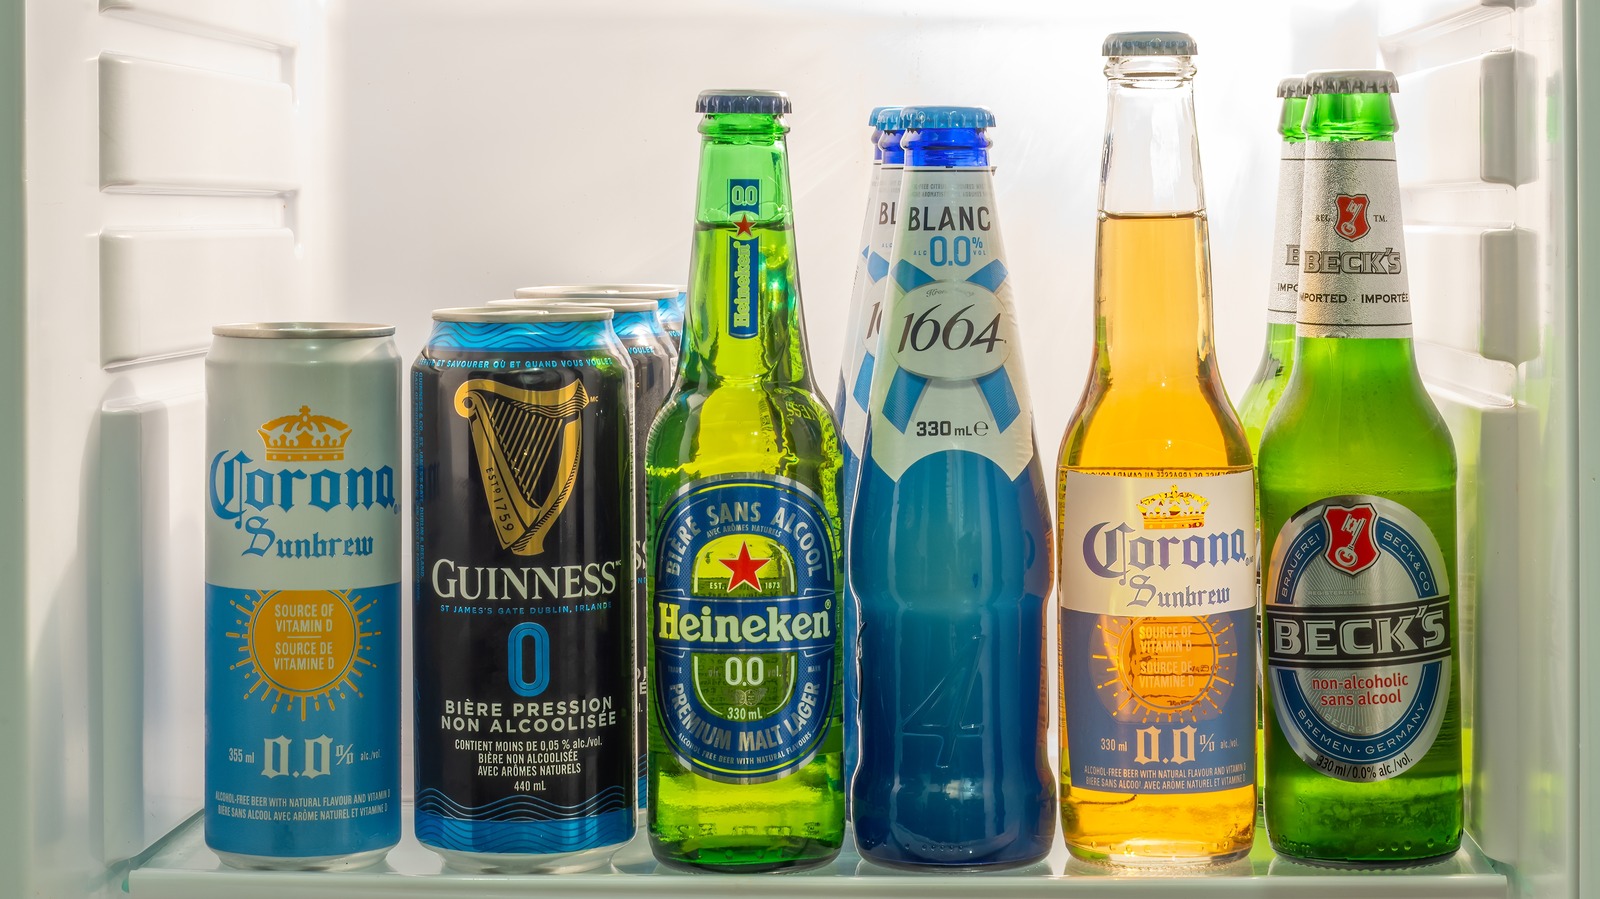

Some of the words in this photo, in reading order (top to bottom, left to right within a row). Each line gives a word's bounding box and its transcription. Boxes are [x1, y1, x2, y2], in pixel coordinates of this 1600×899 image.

[731, 185, 758, 206] 0.0
[908, 206, 991, 231] BLANC
[1373, 214, 1388, 223] TM.
[929, 235, 983, 267] 0.0%
[1304, 247, 1402, 274] BECK'S
[734, 243, 750, 327] Heineken
[1277, 282, 1299, 292] IMPO
[898, 303, 1005, 353] 1664
[447, 360, 489, 368] SAVOURER
[493, 359, 506, 369] OÙ
[524, 360, 557, 368] QUAND
[561, 359, 583, 367] VOUS
[586, 358, 612, 366] VOULEZ
[916, 421, 951, 437] 330
[955, 426, 972, 436] mL
[209, 450, 396, 530] Corona
[494, 497, 514, 531] 1759
[241, 516, 374, 559] Sunbrew
[665, 515, 702, 577] BIÈRE
[706, 501, 762, 526] SANS
[770, 507, 823, 578] ALCOOL
[706, 527, 721, 538] AVEC
[723, 522, 749, 533] ARÔMES
[751, 524, 782, 538] NATURELS
[1082, 521, 1246, 586] Corona
[1281, 533, 1320, 598] BRAUEREI
[432, 558, 616, 600] GUINNESS
[709, 582, 725, 590] EST.
[765, 581, 781, 590] 1873
[1126, 574, 1230, 608] Sunbrew
[274, 603, 316, 618] SOURCE
[321, 603, 335, 617] OF
[440, 604, 450, 612] ST
[453, 605, 493, 615] JAMES'S
[498, 607, 524, 615] GATE
[575, 602, 612, 613] IRLANDE
[275, 619, 322, 633] VITAMIN
[325, 619, 333, 632] D
[658, 602, 831, 643] Heineken
[1139, 625, 1178, 639] SOURCE
[1181, 625, 1193, 639] OF
[1273, 605, 1446, 656] BECK'S
[275, 642, 316, 655] SOURCE
[319, 641, 333, 655] DE
[1140, 640, 1183, 653] VITAMIN
[1186, 640, 1192, 652] D
[273, 657, 324, 671] VITAMINE
[327, 657, 335, 670] D
[508, 621, 550, 697] 0
[1140, 661, 1178, 674] SOURCE
[1181, 661, 1192, 674] DE
[725, 656, 764, 687] 0.0
[1139, 675, 1185, 688] VITAMINE
[1189, 675, 1195, 686] D
[1312, 673, 1408, 690] non-alcoholic
[445, 698, 503, 718] BIÈRE
[513, 696, 613, 718] PRESSION
[1321, 694, 1354, 706] sans
[1358, 689, 1402, 705] alcool
[441, 716, 480, 733] NON
[490, 707, 617, 733] ALCOOLISÉE
[670, 682, 731, 751] PREMIUM
[738, 724, 783, 751] MALT
[783, 682, 821, 736] LAGER
[727, 708, 747, 720] 330
[748, 707, 763, 720] mL
[1297, 709, 1353, 754] BREMEN
[1365, 703, 1425, 754] GERMANY
[455, 738, 492, 752] CONTIENT
[495, 740, 524, 753] MOINS
[526, 741, 538, 752] DE
[562, 739, 571, 749] %
[572, 735, 603, 749] alc./vol.
[701, 750, 717, 761] FREE
[719, 755, 734, 764] BEER
[736, 757, 754, 765] WITH
[756, 751, 785, 764] NATURAL
[786, 731, 812, 755] FLAVOURS
[1100, 738, 1116, 751] 330
[1118, 741, 1128, 752] ml
[1134, 724, 1215, 765] 0.0%
[228, 747, 243, 763] 355
[245, 750, 255, 764] ml
[260, 733, 354, 779] 0.0%
[478, 751, 503, 764] BIÈRE
[506, 753, 525, 764] NON
[527, 749, 578, 764] ALCOOLISÉE
[1316, 755, 1334, 772] 330
[1378, 752, 1413, 776] alc./vol.
[478, 765, 499, 777] AVEC
[501, 761, 537, 777] ARÔMES
[539, 762, 582, 777] NATURELS
[1084, 765, 1122, 777] ALCOHOL-FREE
[1123, 768, 1138, 778] BEER
[1140, 769, 1157, 778] WITH
[1158, 769, 1186, 779] NATURAL
[1188, 767, 1213, 778] FLAVOUR
[1214, 766, 1225, 776] AND
[1226, 763, 1243, 774] VITAMIN
[514, 781, 531, 792] 440
[533, 780, 547, 791] mL
[1101, 778, 1118, 788] SANS
[1144, 781, 1161, 790] AVEC
[1162, 779, 1185, 790] ARÔME
[1186, 778, 1213, 789] NATUREL
[1214, 777, 1220, 787] ET
[1221, 774, 1242, 786] VITAMINE
[215, 791, 250, 806] ALCOHOL-FREE
[251, 796, 267, 807] BEER
[268, 797, 287, 807] WITH
[289, 797, 321, 808] NATURAL
[323, 795, 352, 806] FLAVOUR
[353, 793, 367, 804] AND
[367, 789, 387, 802] VITAMIN
[231, 807, 247, 819] SANS
[247, 809, 272, 820] ALCOOL
[273, 811, 291, 821] AVEC
[293, 808, 318, 821] ARÔME
[320, 808, 350, 820] NATUREL
[351, 807, 359, 818] ET
[360, 804, 384, 817] VITAMINE
